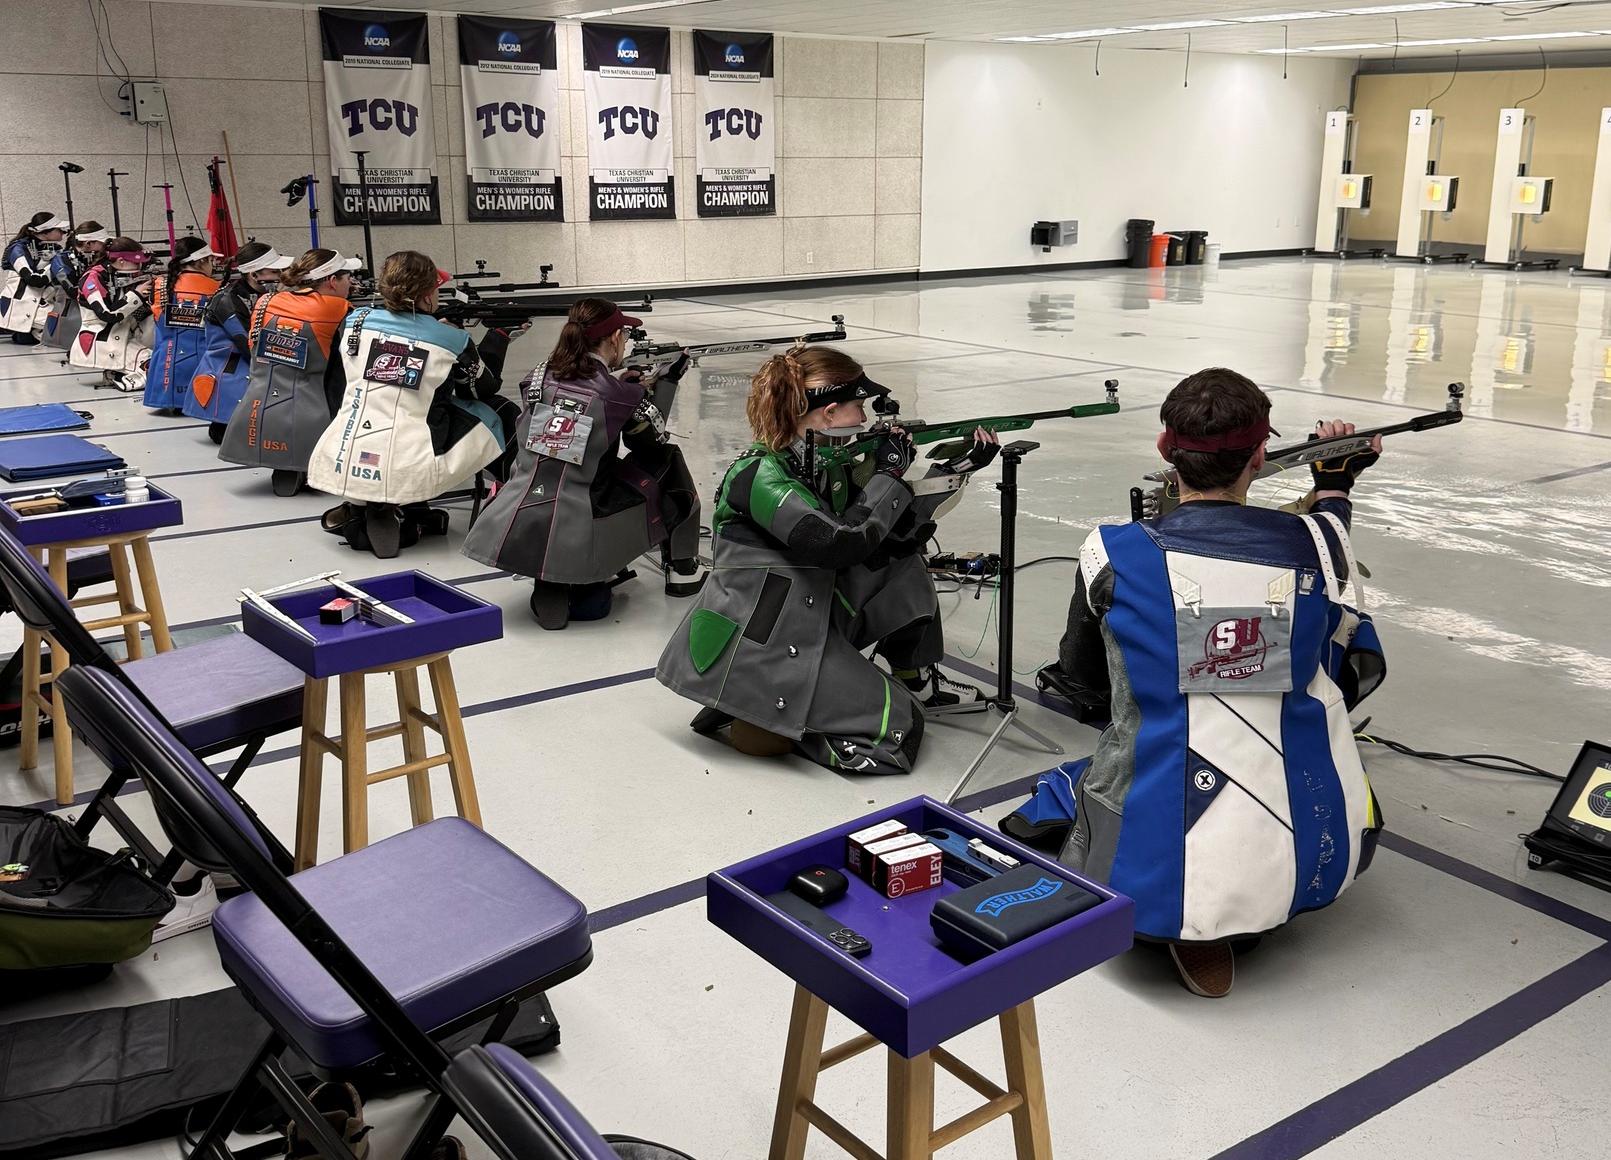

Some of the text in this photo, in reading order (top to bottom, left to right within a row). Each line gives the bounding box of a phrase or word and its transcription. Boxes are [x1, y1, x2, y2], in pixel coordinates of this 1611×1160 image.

[364, 37, 390, 46] NCAA
[498, 43, 521, 52] NCAA
[618, 50, 639, 58] NCAA
[725, 55, 744, 63] NCAA
[341, 99, 419, 137] TCU
[476, 102, 545, 139] TCU
[599, 106, 659, 141] TCU
[705, 108, 762, 141] TCU
[1331, 118, 1336, 126] 1
[1415, 116, 1421, 126] 2
[1505, 116, 1512, 125] 3
[343, 196, 431, 212] CHAMPION
[476, 195, 554, 210] CHAMPION
[597, 194, 667, 209] CHAMPION
[704, 191, 769, 206] CHAMPION
[709, 343, 750, 354] WALTHER
[249, 400, 261, 446] PAIGE
[335, 388, 363, 474] ISABELLA
[264, 440, 288, 450] USA
[1306, 443, 1353, 460] WALTHER
[352, 466, 381, 480] USA
[1216, 617, 1261, 650] SU
[1220, 665, 1261, 678] RIFLE TEAM
[891, 861, 917, 874] tenex
[930, 855, 942, 885] ELEY
